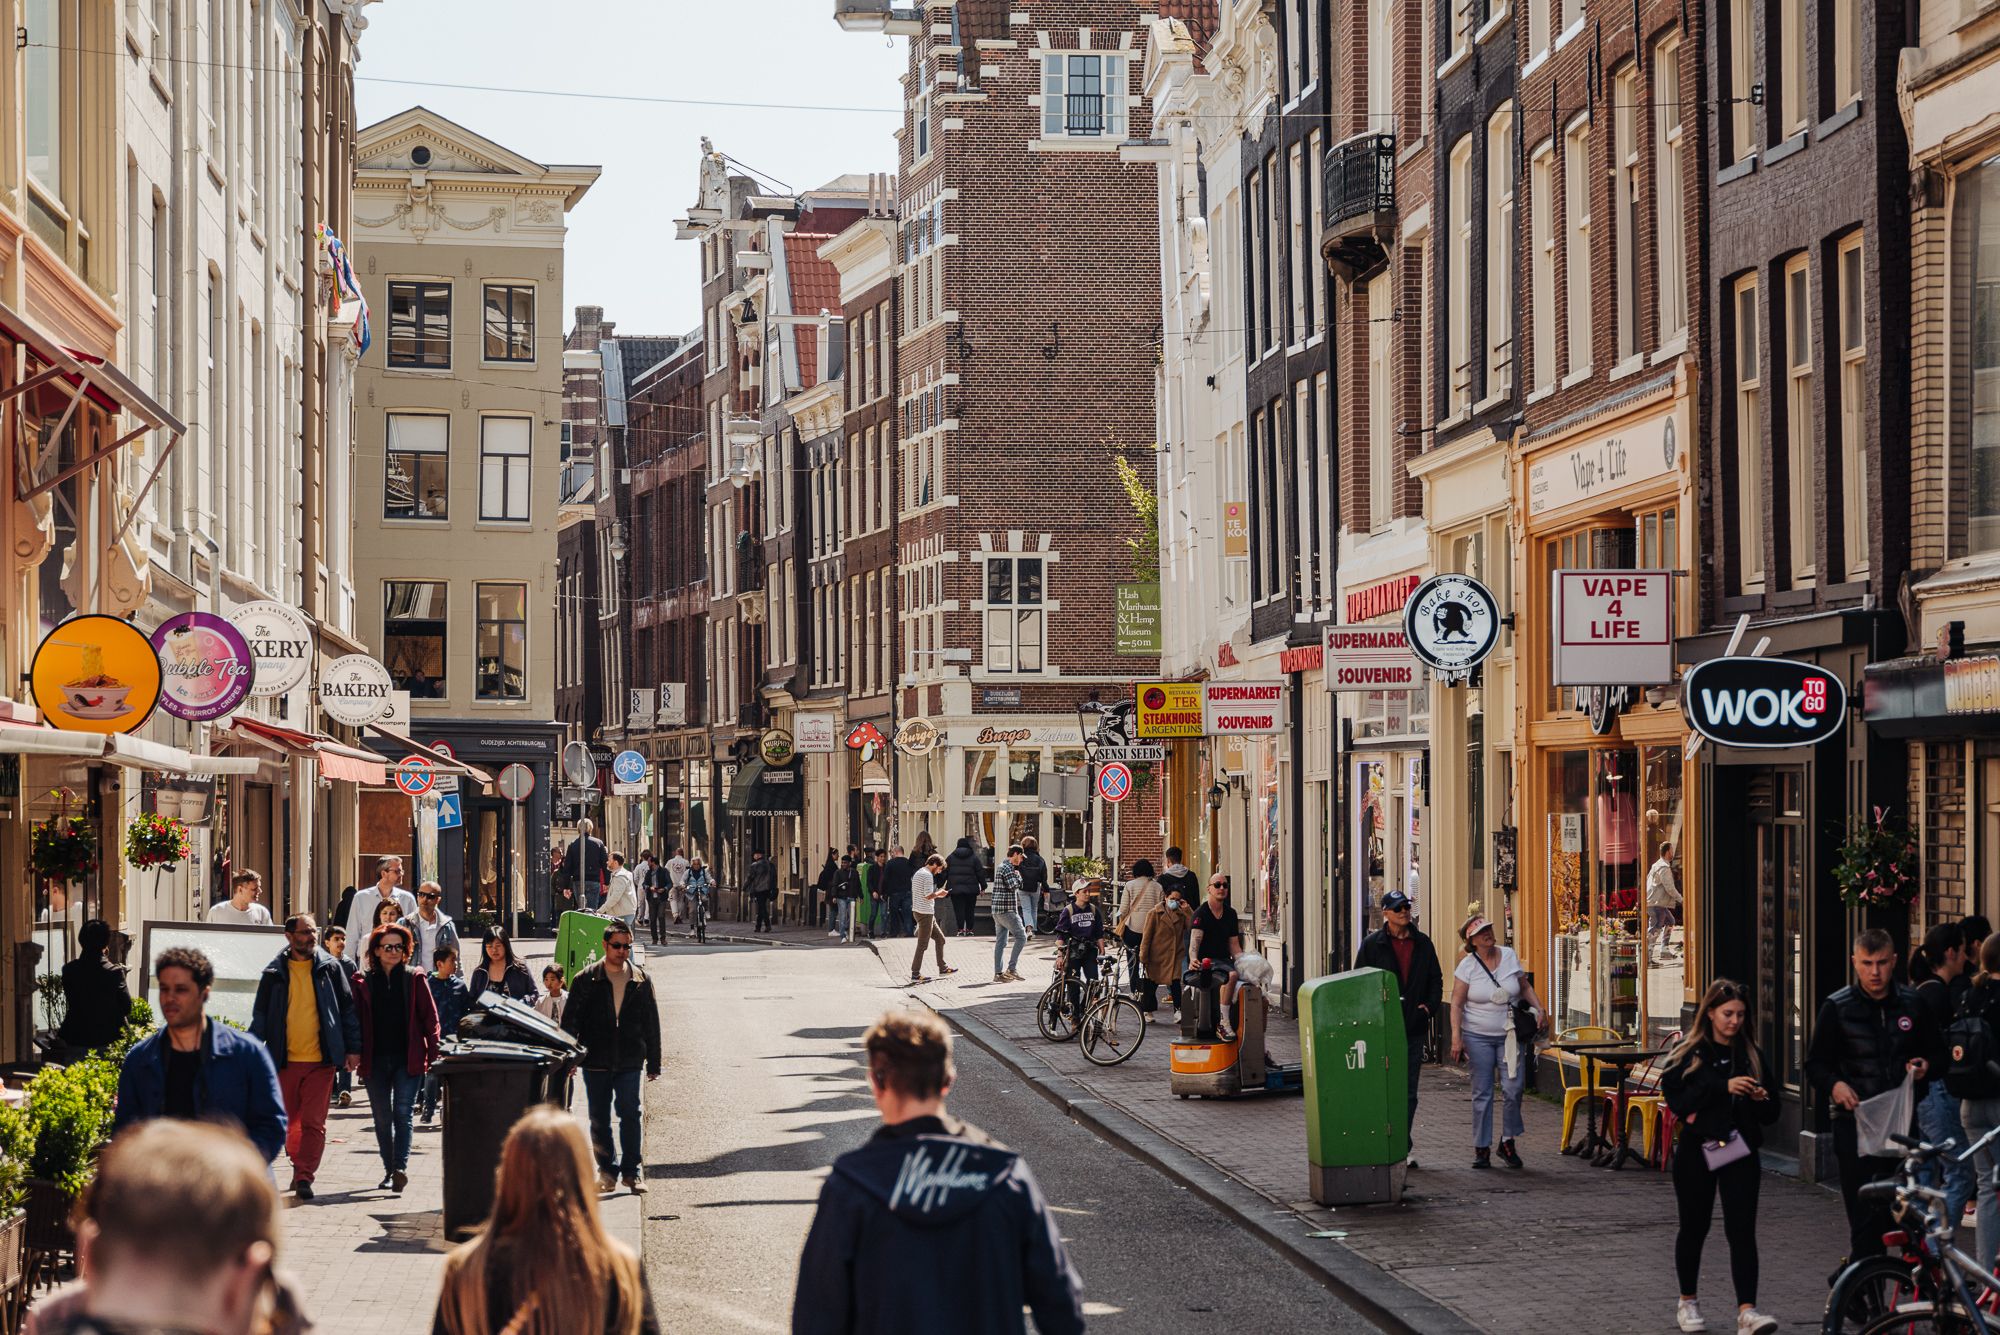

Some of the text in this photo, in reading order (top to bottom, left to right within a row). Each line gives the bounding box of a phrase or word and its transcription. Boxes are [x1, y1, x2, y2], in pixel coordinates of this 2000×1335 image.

[1571, 452, 1595, 495] Vape
[1607, 439, 1627, 480] Life
[1227, 519, 1241, 529] TE
[1118, 588, 1139, 599] Hash
[1583, 578, 1648, 597] VAPE
[1118, 600, 1161, 610] Marihuana
[1420, 588, 1486, 617] Bake shop
[1607, 600, 1623, 617] 4
[232, 607, 254, 622] WEET
[1117, 612, 1155, 625] & Hemp
[255, 625, 271, 637] The
[1118, 625, 1151, 636] Museum
[1591, 621, 1640, 638] LIFE
[1328, 632, 1408, 649] SUPERMARK
[248, 640, 308, 658] KERY
[214, 657, 249, 680] Tea
[1338, 667, 1412, 684] SOUVENIRS
[350, 672, 362, 681] The
[254, 681, 288, 692] TERDAM
[322, 683, 390, 698] BAKERY
[1207, 686, 1281, 700] SUPERMARKET
[1805, 680, 1824, 695] TO
[182, 707, 217, 716] CHURROS
[220, 684, 242, 709] CREPES
[632, 690, 640, 713] KOK
[663, 684, 671, 708] KOK
[1173, 697, 1198, 707] TER
[1701, 688, 1817, 728] WOK
[1805, 697, 1825, 711] GO
[1143, 712, 1202, 725] STEAKHOUSE
[1217, 715, 1273, 729] SOUVENIRS
[895, 729, 939, 745] Burger
[977, 727, 1031, 746] Burger
[1099, 747, 1162, 760] SENSI SEEDS
